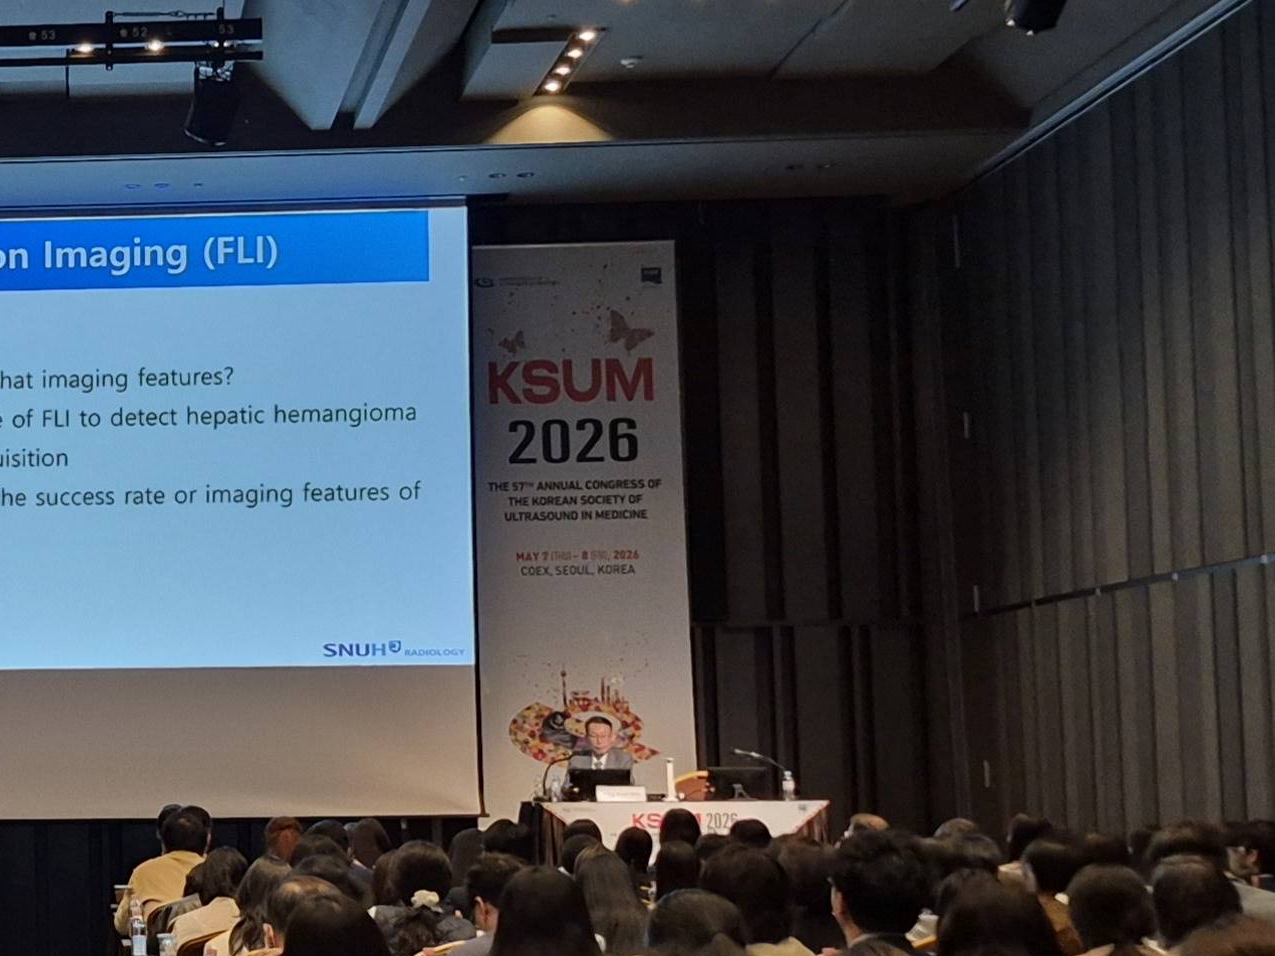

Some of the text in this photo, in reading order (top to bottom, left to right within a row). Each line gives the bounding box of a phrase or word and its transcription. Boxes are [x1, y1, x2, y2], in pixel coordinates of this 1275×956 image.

[45, 237, 186, 275] Imaging
[204, 236, 277, 269] (FLI)
[43, 369, 127, 393] imaging
[138, 367, 233, 386] features?
[488, 357, 654, 405] KSUM
[12, 409, 33, 428] of
[43, 410, 69, 427] FLI
[80, 411, 100, 427] to
[111, 407, 177, 426] detect
[187, 405, 264, 429] hepatic
[275, 403, 416, 427] hemangioma
[509, 417, 638, 464] 2026
[488, 482, 509, 491] THE
[537, 481, 582, 490] ANNUAL
[586, 480, 645, 489] CONGRESS
[648, 479, 661, 488] OF
[36, 491, 114, 506] success
[125, 488, 165, 505] rate
[175, 490, 196, 504] or
[207, 484, 292, 508] imaging
[304, 482, 389, 502] features
[399, 480, 421, 500] of
[508, 495, 643, 506] THE KOREAN SOCIETY OF
[505, 510, 648, 521] ULTRASOUND IN MEDICINE
[516, 552, 539, 561] MAY
[542, 552, 548, 560] 7
[613, 550, 639, 559] 2026
[521, 565, 636, 576] COEX, SEOUL, KOREA
[323, 643, 386, 657] SNUH
[707, 813, 738, 829] 2026
